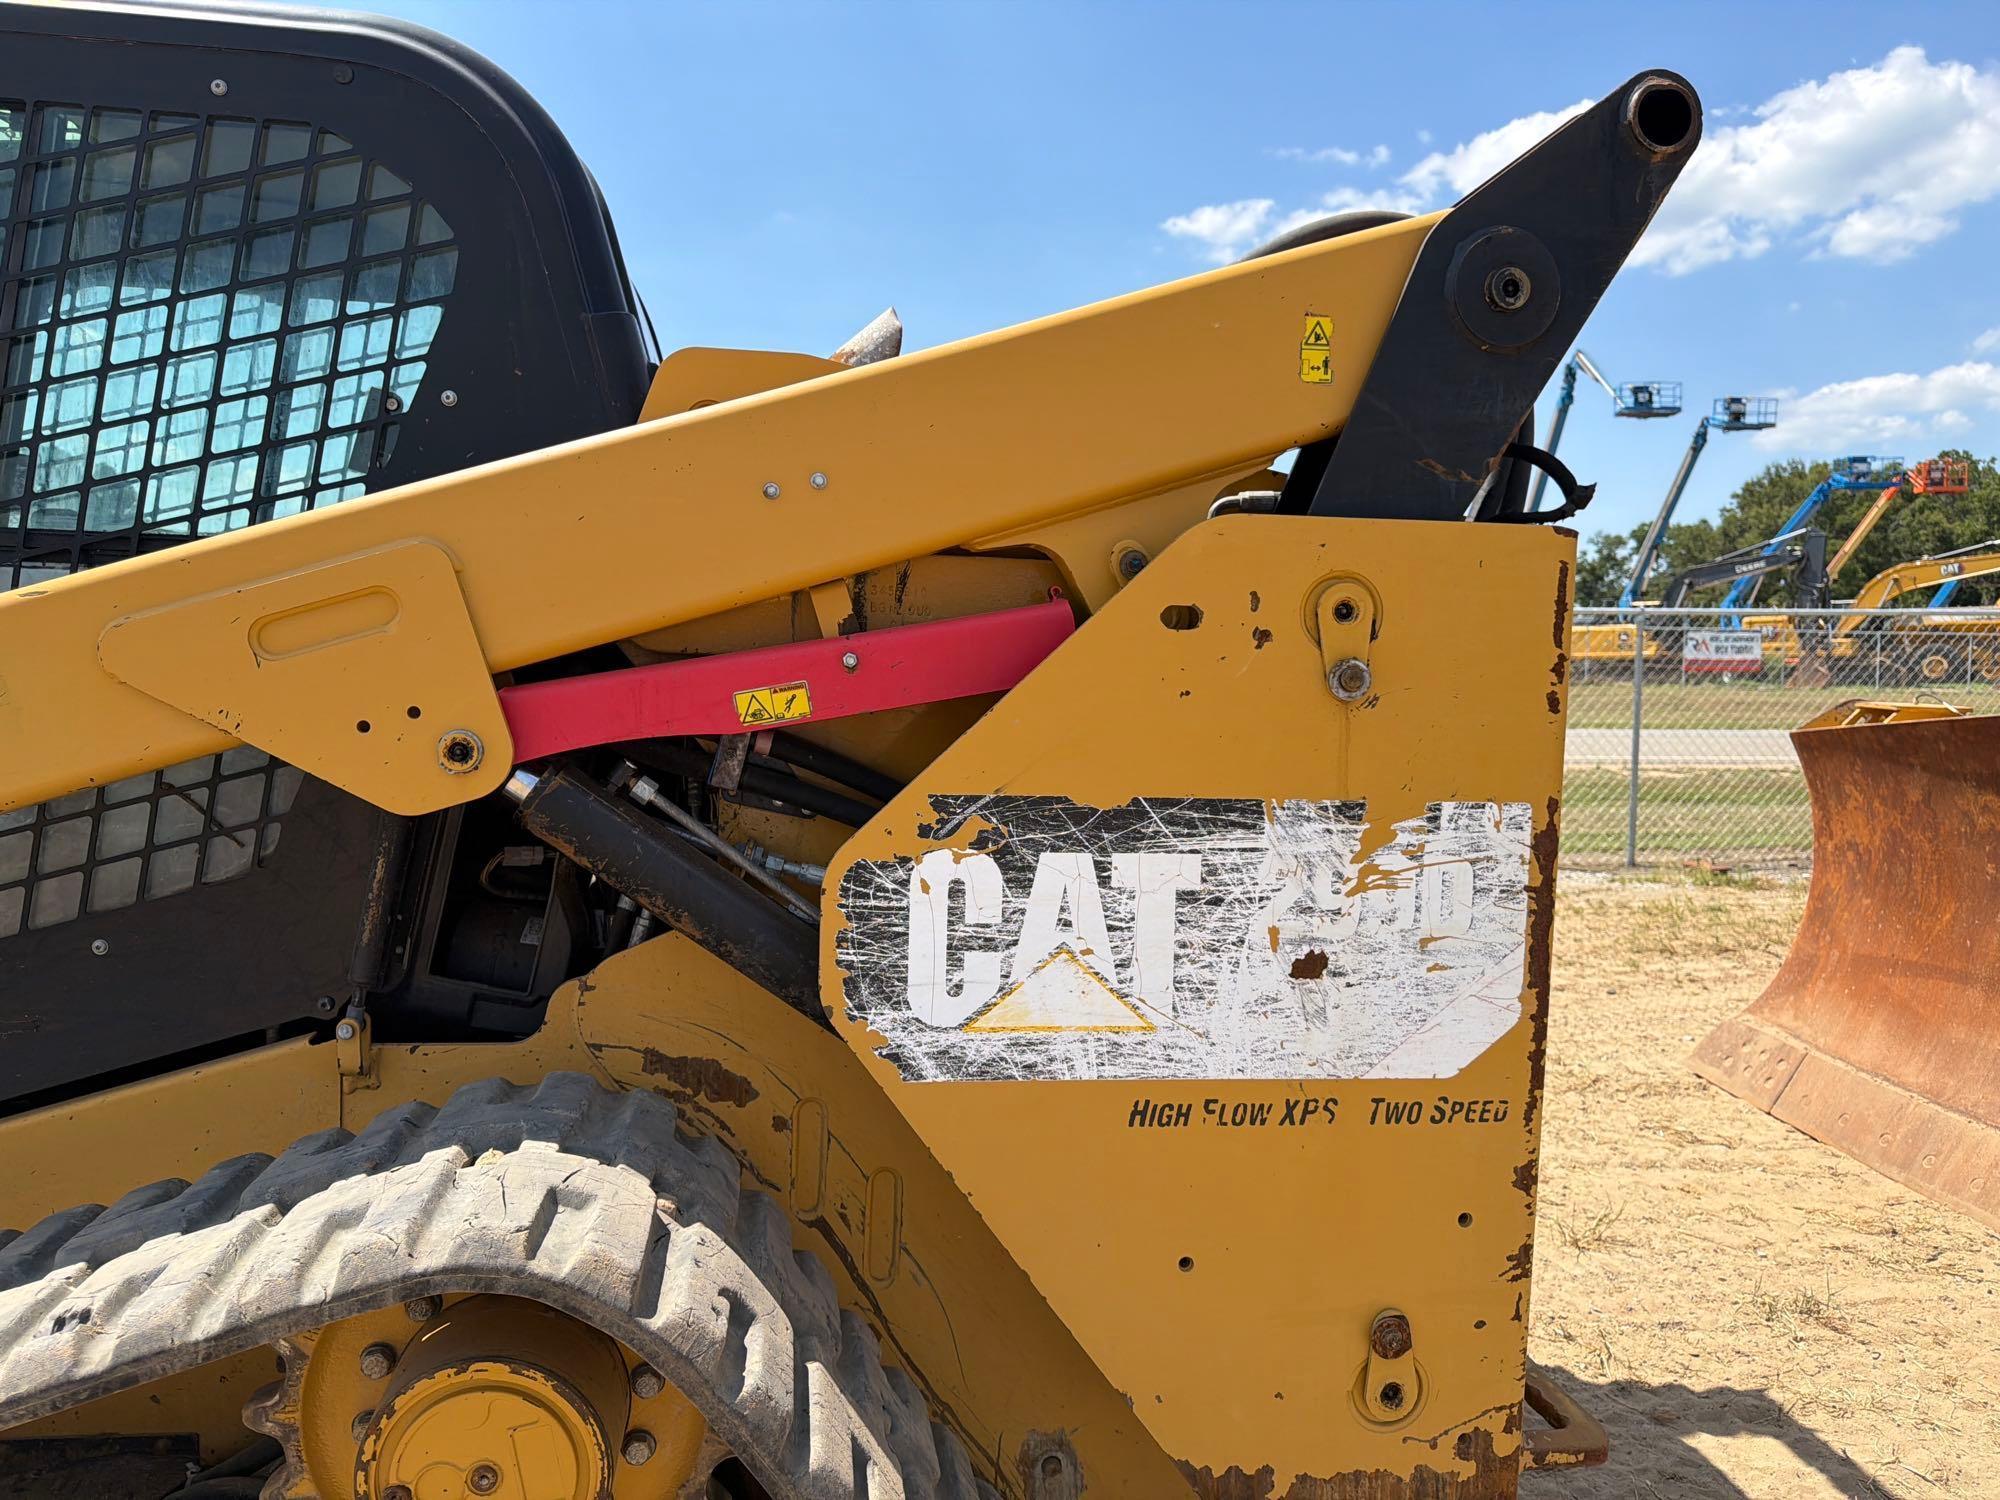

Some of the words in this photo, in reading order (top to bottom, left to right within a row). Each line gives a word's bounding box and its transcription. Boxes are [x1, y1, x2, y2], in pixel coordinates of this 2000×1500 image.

[1940, 562, 1960, 577] CAT
[778, 683, 805, 693] WARNING
[906, 850, 1203, 1029] CAT
[1128, 1098, 1193, 1128] HIGH
[1202, 1098, 1274, 1127] FLOW
[1278, 1097, 1339, 1126] XPS
[1369, 1097, 1424, 1126] TWO
[1429, 1095, 1510, 1126] SPEED
